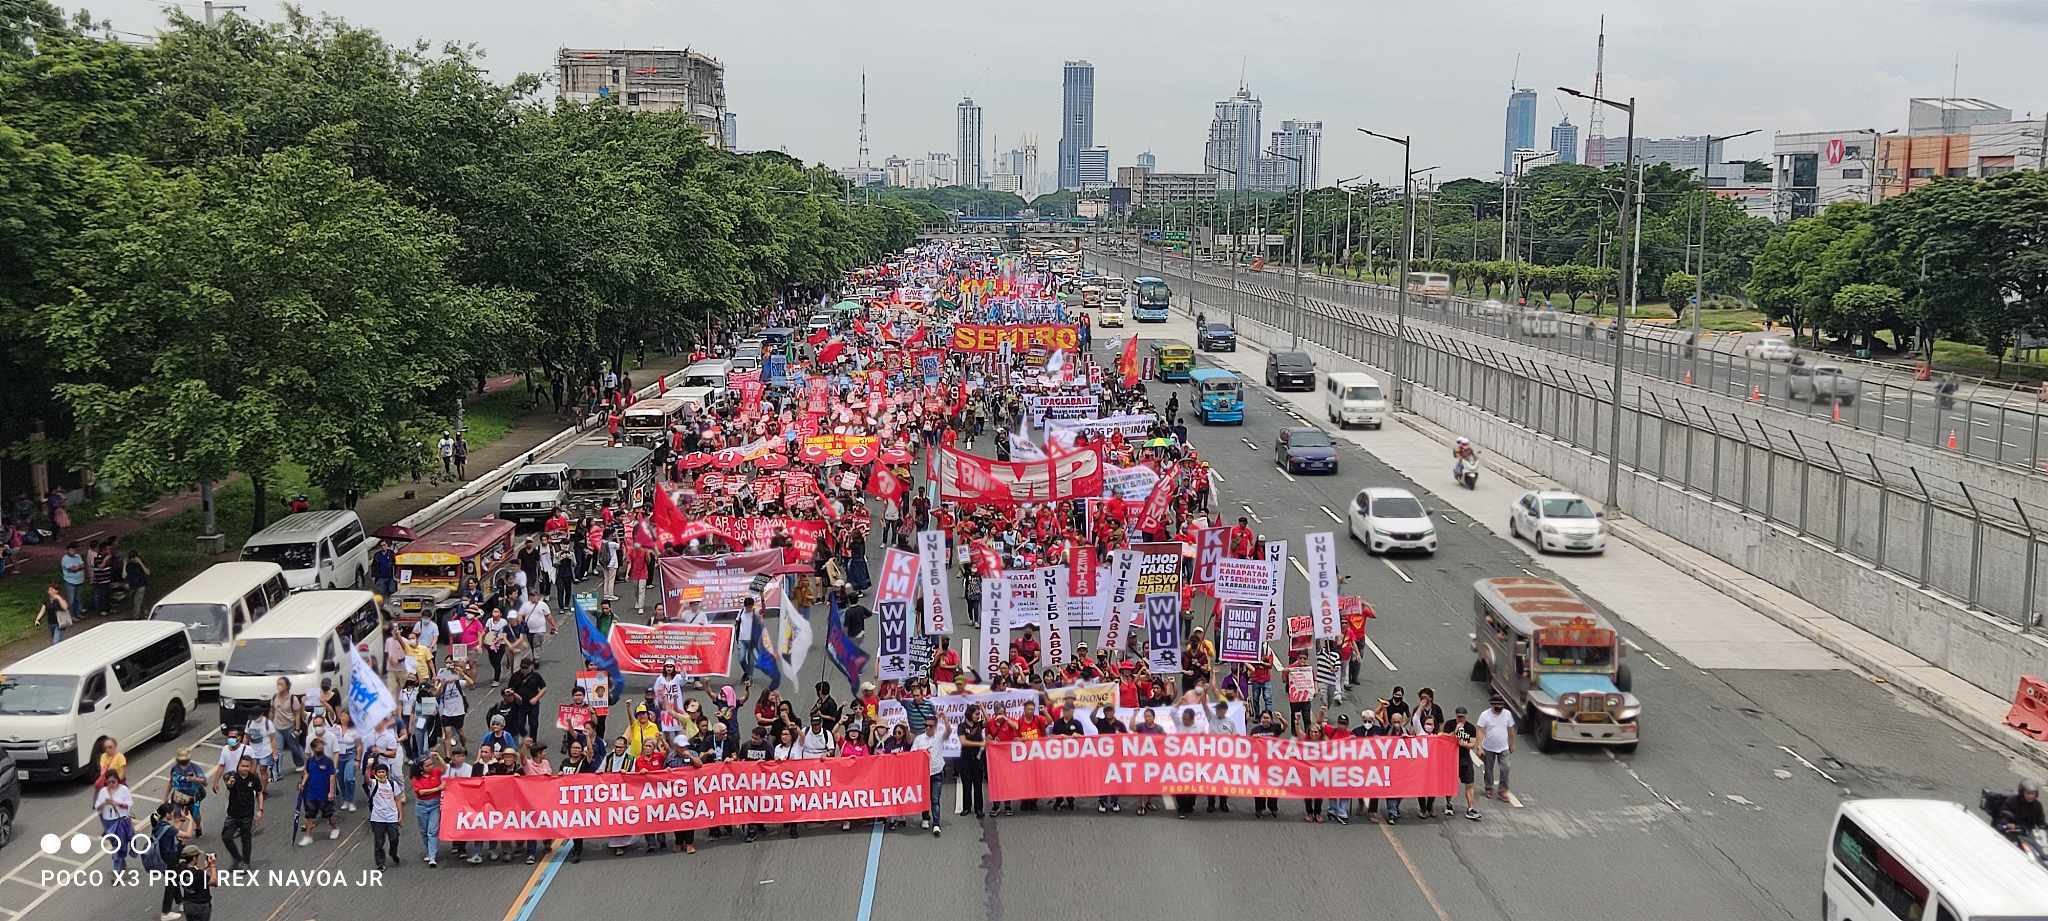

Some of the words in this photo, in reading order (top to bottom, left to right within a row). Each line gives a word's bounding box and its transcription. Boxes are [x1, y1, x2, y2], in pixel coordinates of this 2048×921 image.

[954, 326, 1078, 350] SENTRO
[926, 534, 941, 586] UNITED
[1077, 551, 1090, 595] SENTRO
[1141, 554, 1179, 563] AHOD
[1200, 530, 1224, 582] KMU
[1314, 536, 1329, 588] UNITED
[1044, 570, 1060, 621] UNITED
[1115, 553, 1134, 603] UNITED
[1136, 585, 1176, 594] BABA!
[1137, 575, 1179, 585] RESYO
[881, 604, 905, 652] WWU
[932, 589, 945, 632] LABOR
[990, 582, 1002, 635] UNITED
[1105, 606, 1121, 649] LABOR
[1151, 599, 1174, 646] WWU
[1228, 609, 1257, 621] UNION
[1265, 599, 1277, 640] LABOR
[1320, 591, 1333, 634] LABOR
[1049, 624, 1063, 666] LABOR
[1226, 640, 1256, 651] CRIME!
[1227, 628, 1245, 640] NOT
[988, 637, 1001, 680] LABOR
[560, 705, 589, 715] DEFEND
[946, 703, 965, 713] ANG
[1011, 737, 1115, 762] DAGDAG
[1122, 736, 1158, 758] NA
[1164, 736, 1259, 763] SAHOD,
[1266, 738, 1429, 761] KABUHAYAN
[559, 784, 634, 805] ITIGIL
[640, 779, 688, 800] ANG
[694, 769, 832, 796] KARAHASAN!
[1104, 763, 1137, 784] AT
[1144, 763, 1261, 786] PAGKAIN
[1267, 766, 1302, 786] SA
[1310, 765, 1391, 788] MESA!
[456, 808, 601, 830] KAPAKANAN
[608, 806, 640, 826] NG
[646, 801, 715, 823] MASA,
[719, 795, 783, 814] HINDI
[790, 785, 923, 812] MAHARLIKA!
